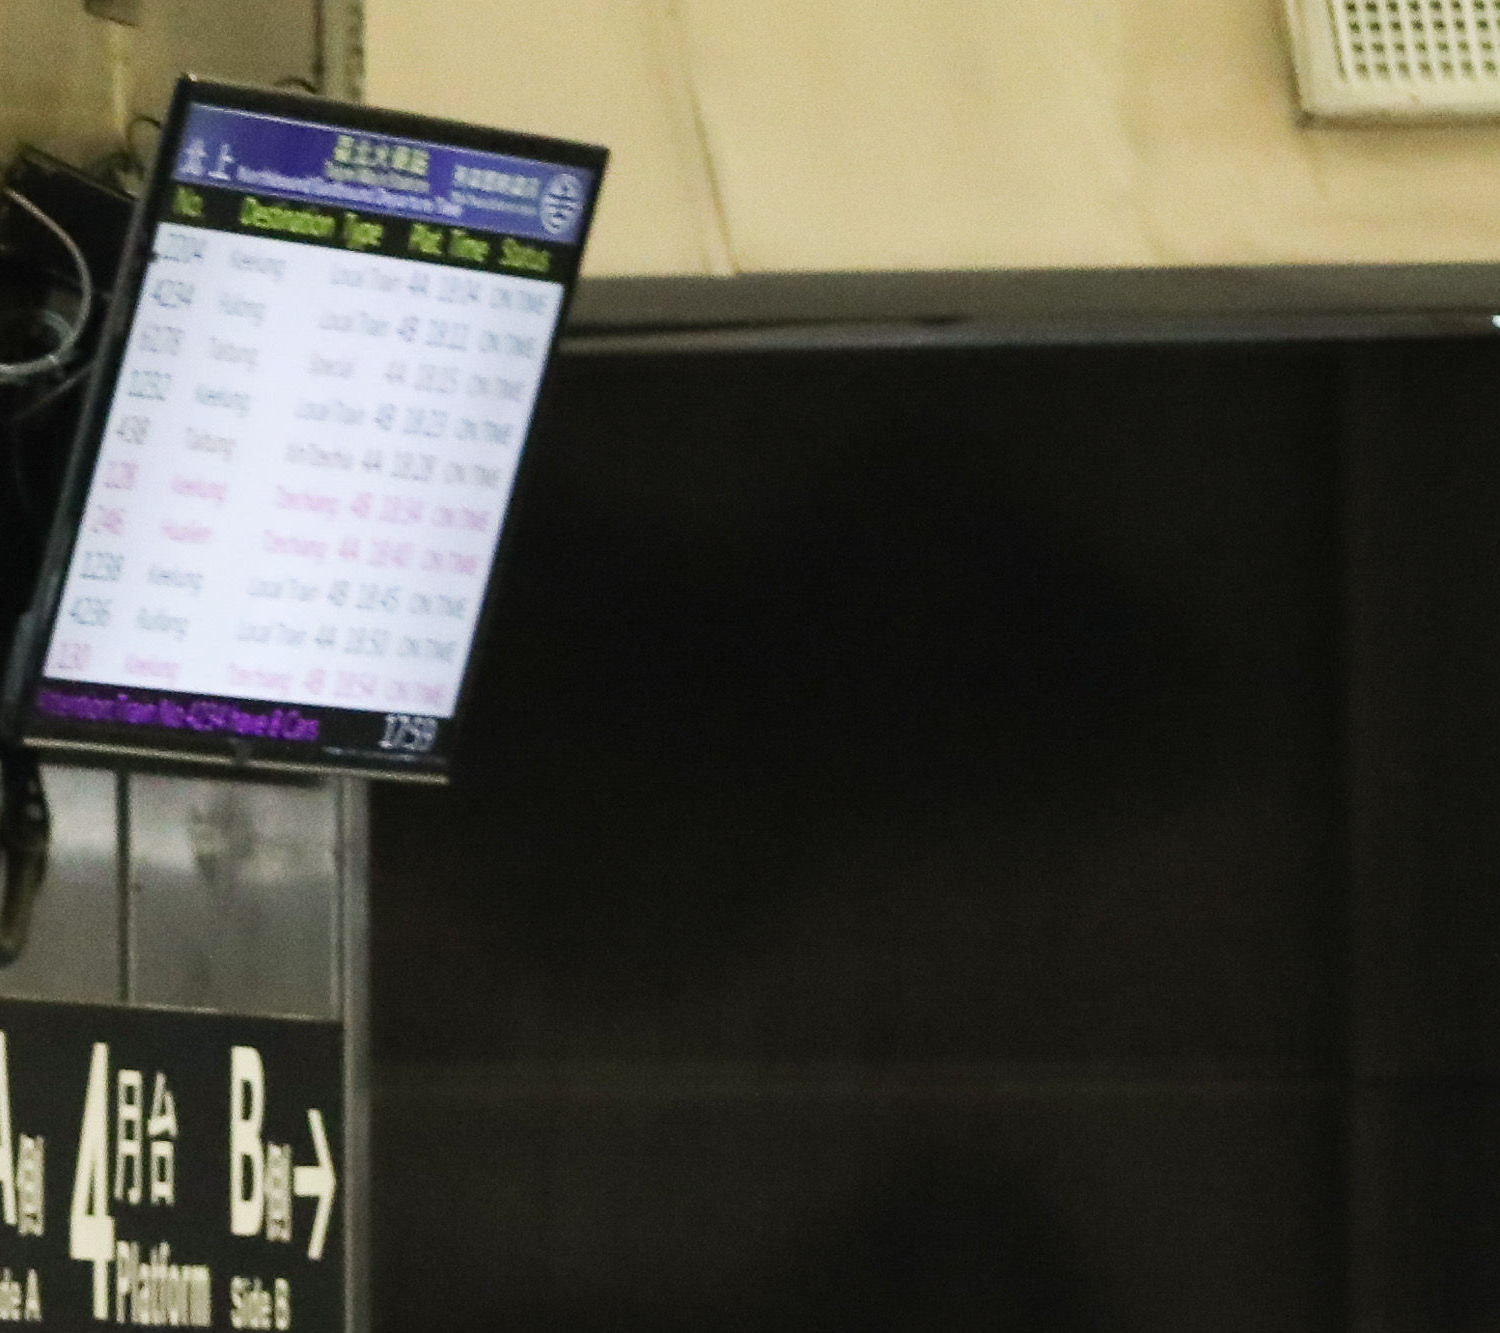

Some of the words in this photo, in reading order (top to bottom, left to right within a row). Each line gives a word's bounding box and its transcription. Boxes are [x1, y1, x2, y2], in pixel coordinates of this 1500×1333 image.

[24, 1268, 43, 1322] A
[115, 1240, 211, 1328] Platform
[274, 1277, 291, 1331] B
